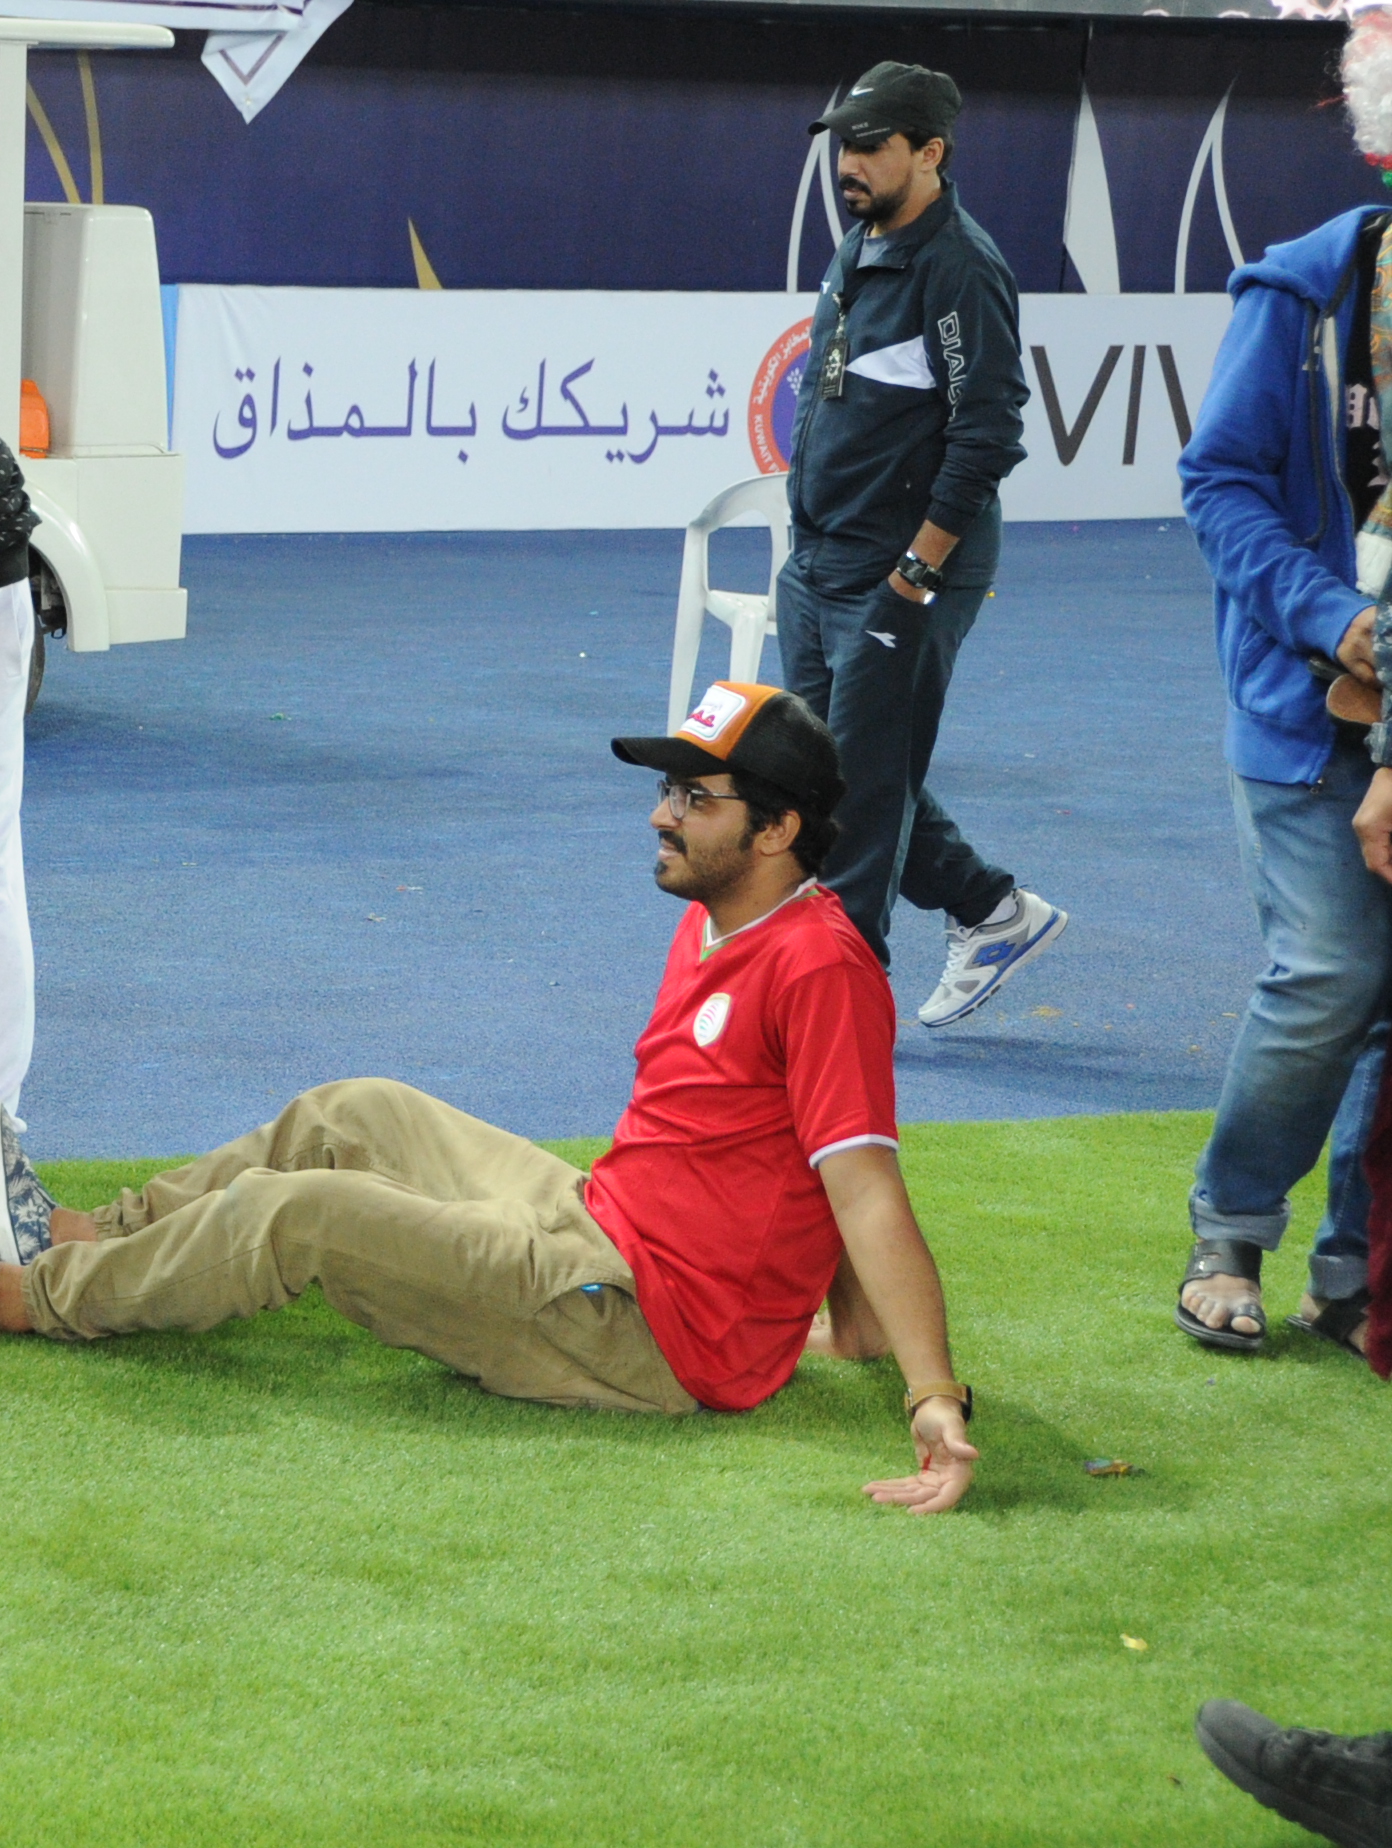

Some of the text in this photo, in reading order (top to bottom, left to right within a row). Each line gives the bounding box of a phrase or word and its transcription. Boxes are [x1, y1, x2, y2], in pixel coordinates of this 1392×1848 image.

[213, 356, 727, 464] شريكك بالمذاق
[754, 413, 774, 464] KUWAIT
